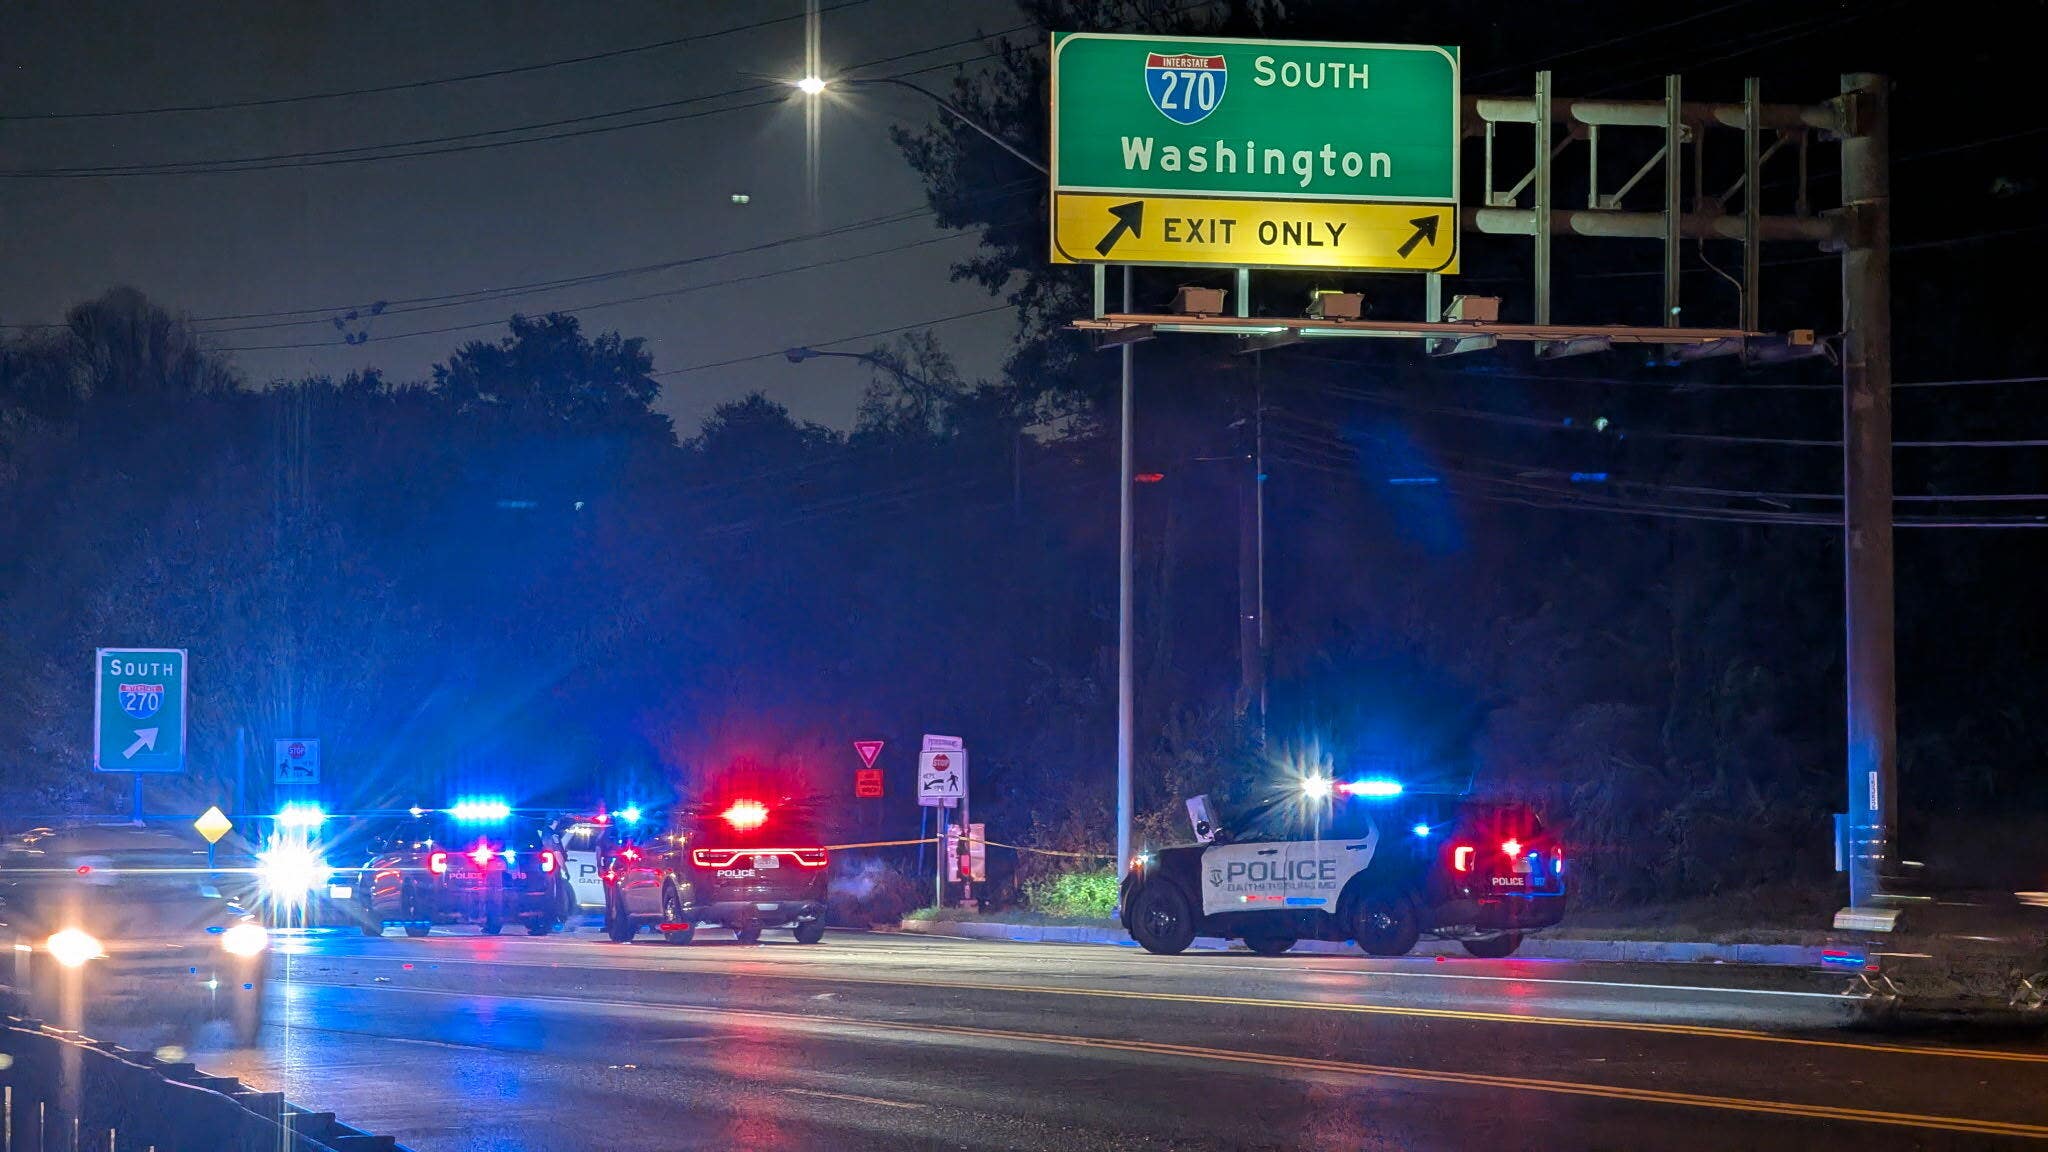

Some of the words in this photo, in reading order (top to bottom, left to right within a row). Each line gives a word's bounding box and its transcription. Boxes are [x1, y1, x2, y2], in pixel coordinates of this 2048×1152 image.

[1162, 57, 1209, 68] INTERSTATE
[1254, 56, 1369, 89] SOUTH
[1161, 71, 1215, 111] 270
[1121, 136, 1391, 187] Washington
[1164, 218, 1236, 243] EXIT
[1258, 221, 1347, 246] ONLY
[110, 659, 173, 676] SOUTH
[126, 692, 159, 711] 270
[449, 872, 483, 880] POLICE
[717, 869, 755, 877] POLICE
[1227, 860, 1336, 882] POLICE
[1492, 877, 1524, 886] POLICE
